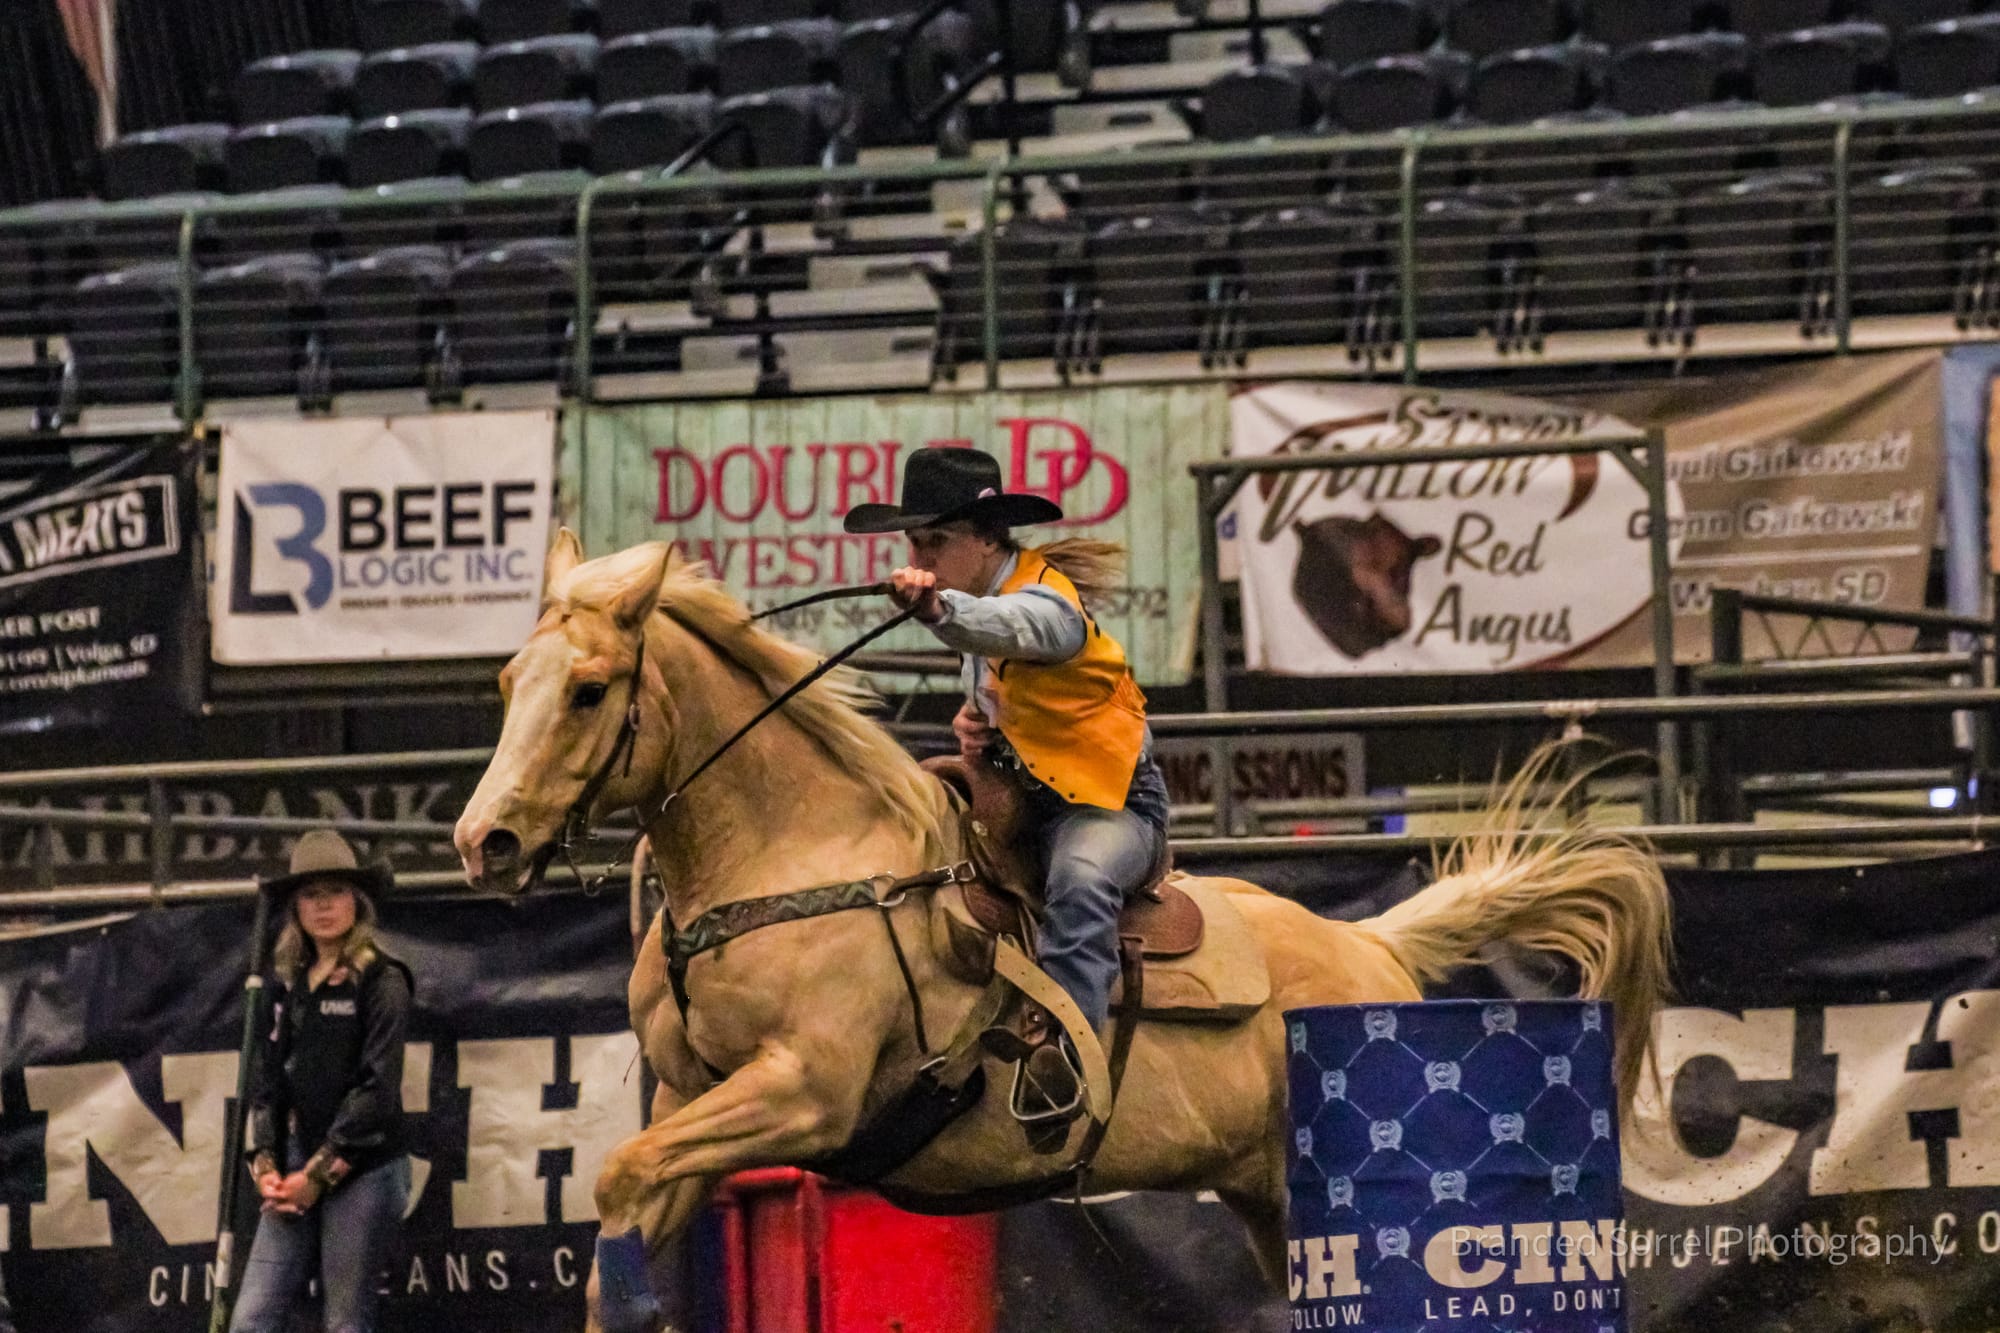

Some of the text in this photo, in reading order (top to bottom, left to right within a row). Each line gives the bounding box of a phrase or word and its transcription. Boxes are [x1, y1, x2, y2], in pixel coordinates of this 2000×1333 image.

[653, 437, 973, 522] DOUBL
[13, 491, 147, 568] MEATS
[338, 481, 535, 553] BEEF
[1445, 512, 1546, 577] Red
[339, 555, 452, 588] LOGIC
[1834, 568, 1889, 605] SD
[1415, 584, 1573, 661] Angus
[1424, 1219, 1627, 1289] CIN
[1288, 1288, 1621, 1331] OLLOW. LEAD, DON'T
